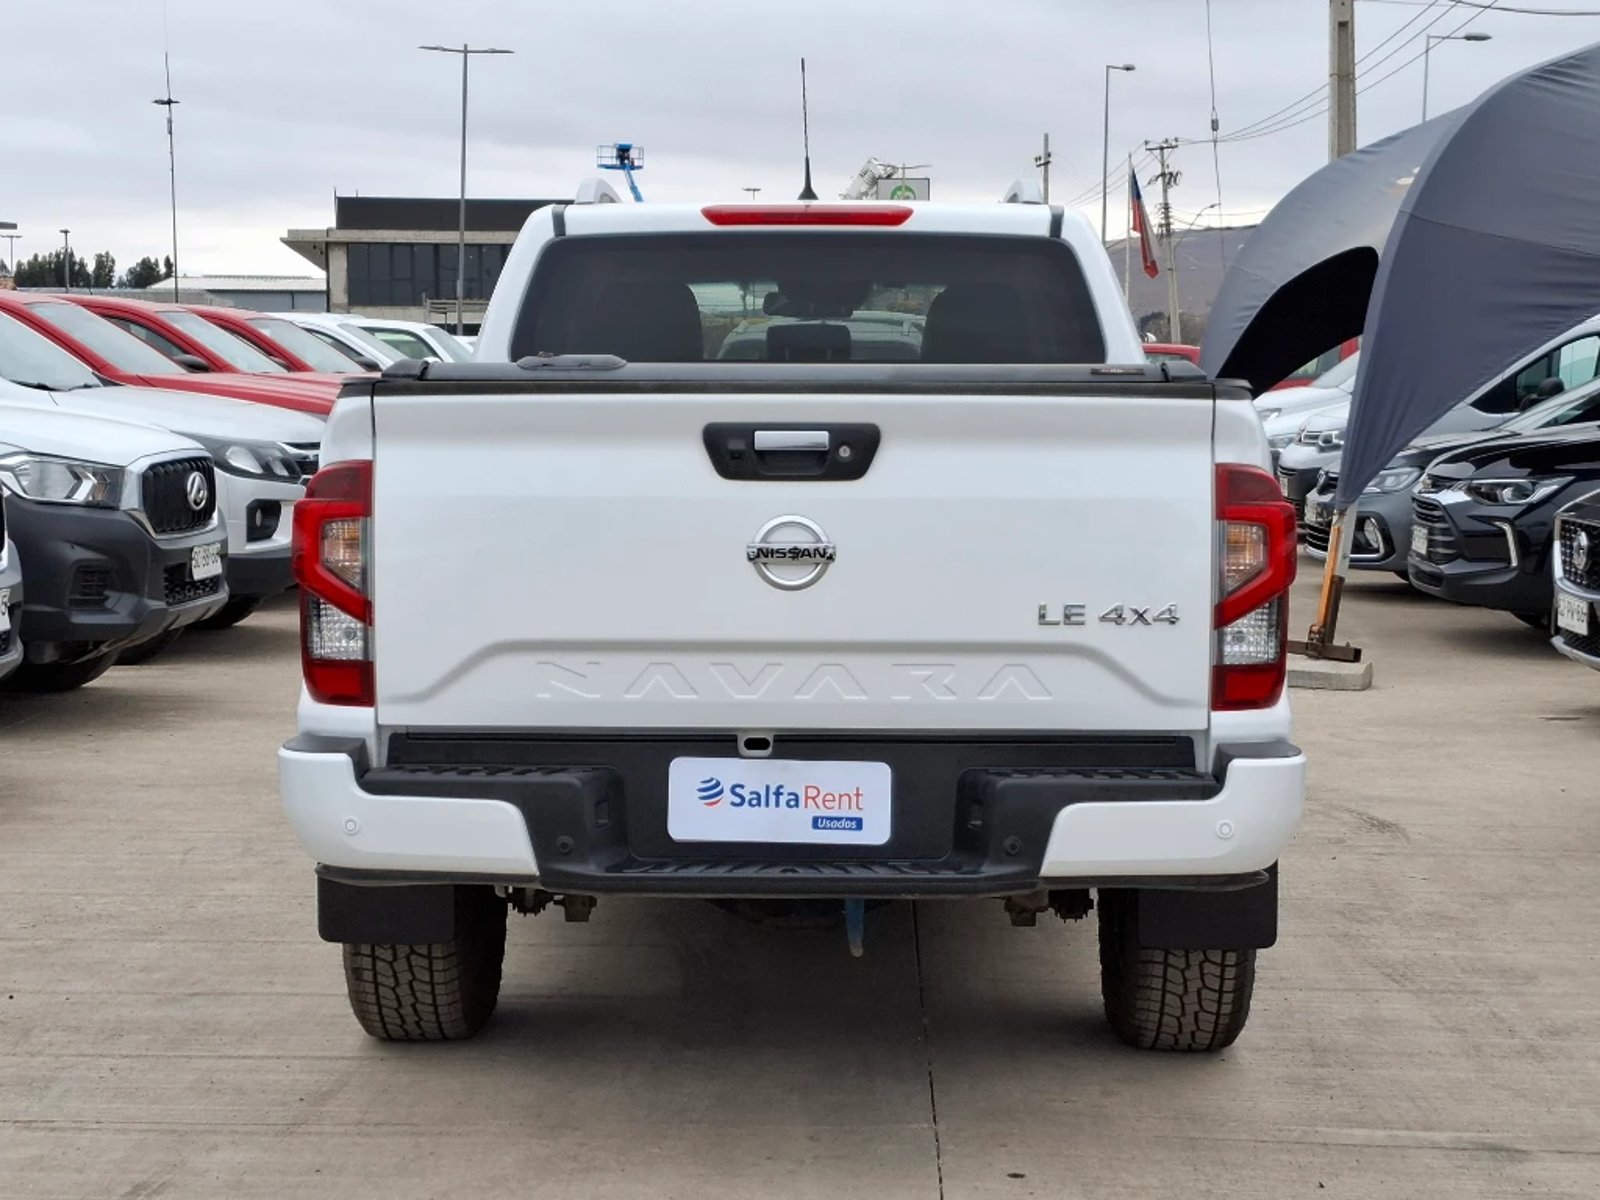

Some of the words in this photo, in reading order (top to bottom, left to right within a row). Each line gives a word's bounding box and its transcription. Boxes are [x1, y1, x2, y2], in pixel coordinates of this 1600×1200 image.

[756, 546, 827, 559] NISSAN
[1038, 602, 1086, 626] LE
[536, 661, 1053, 700] NAVARA
[817, 818, 857, 829] Usados
